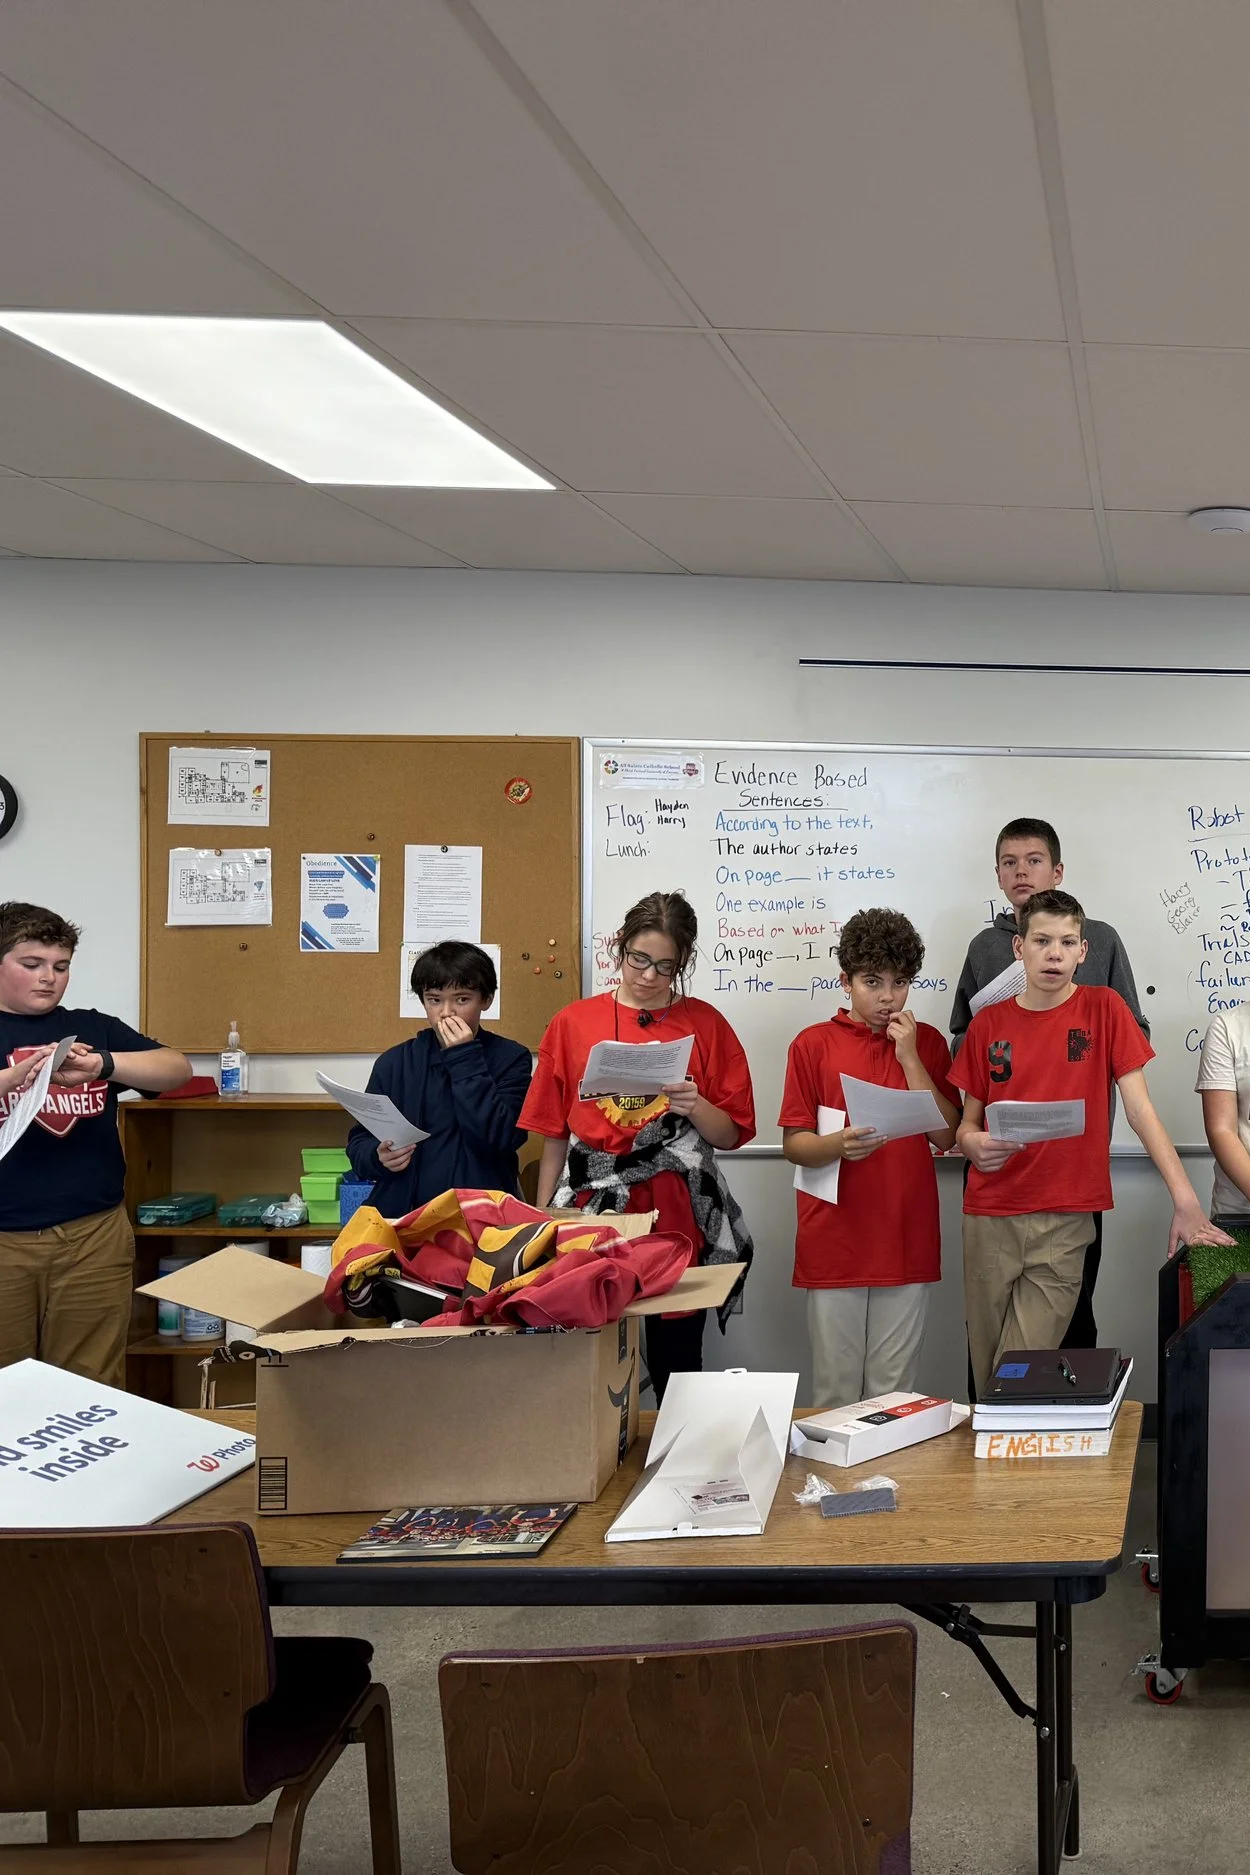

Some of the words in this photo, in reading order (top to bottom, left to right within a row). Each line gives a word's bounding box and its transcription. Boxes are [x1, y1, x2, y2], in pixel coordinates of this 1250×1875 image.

[714, 761, 798, 786] Evidence
[814, 765, 867, 789] Based
[715, 811, 779, 836] According
[782, 814, 802, 831] to
[805, 811, 832, 830] the
[836, 813, 874, 831] text,
[1188, 804, 1245, 831] Robot
[709, 838, 745, 856] The
[752, 838, 802, 856] author
[805, 838, 858, 856] states
[716, 865, 741, 885] On
[745, 869, 783, 887] page
[816, 865, 834, 880] it
[837, 866, 896, 880] states
[715, 896, 742, 913] One
[748, 897, 805, 915] example
[810, 896, 827, 912] is
[717, 918, 765, 938] Based
[770, 926, 786, 939] on
[792, 922, 826, 936] what
[1198, 929, 1250, 951] Trials
[713, 943, 735, 963] On
[739, 946, 773, 972] page
[804, 941, 821, 960] I
[713, 968, 738, 992] In
[744, 976, 775, 993] the
[619, 1096, 646, 1110] 20159
[17, 1404, 118, 1451] smiles
[18, 1435, 130, 1482] inside
[215, 1437, 256, 1461] Photo
